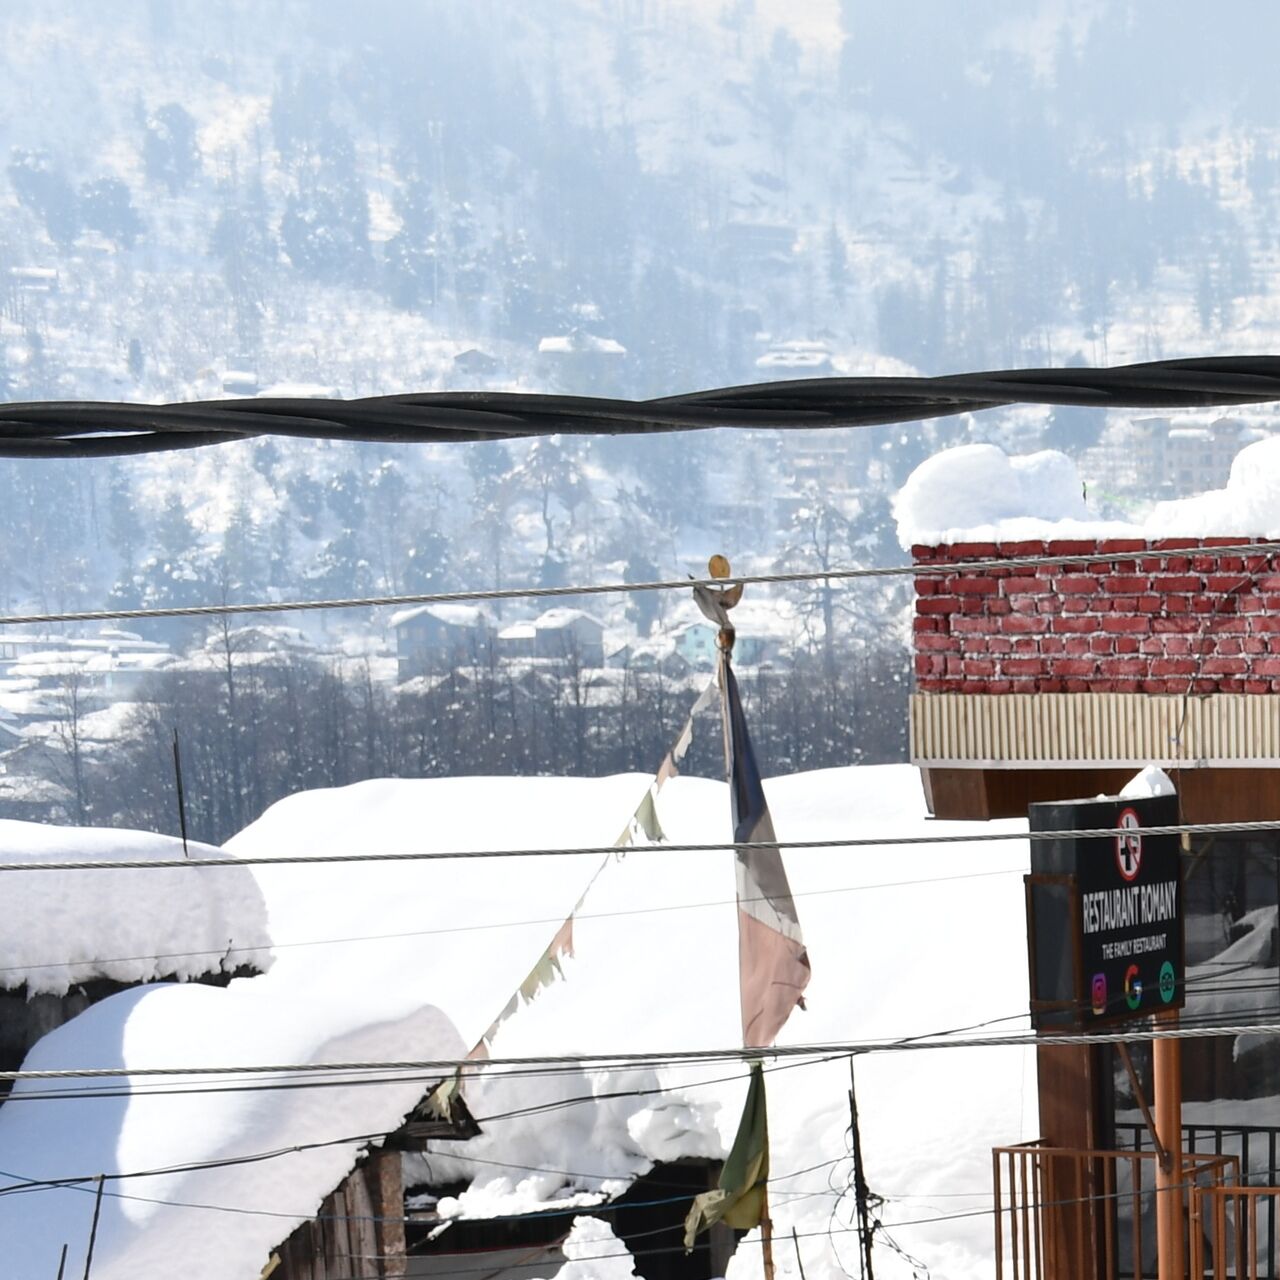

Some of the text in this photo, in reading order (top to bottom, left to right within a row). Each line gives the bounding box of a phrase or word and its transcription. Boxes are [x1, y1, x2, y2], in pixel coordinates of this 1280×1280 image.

[1083, 880, 1177, 934] RESTAURANT ROMANY
[1102, 933, 1167, 960] THE FAMILY RESTAURANT
